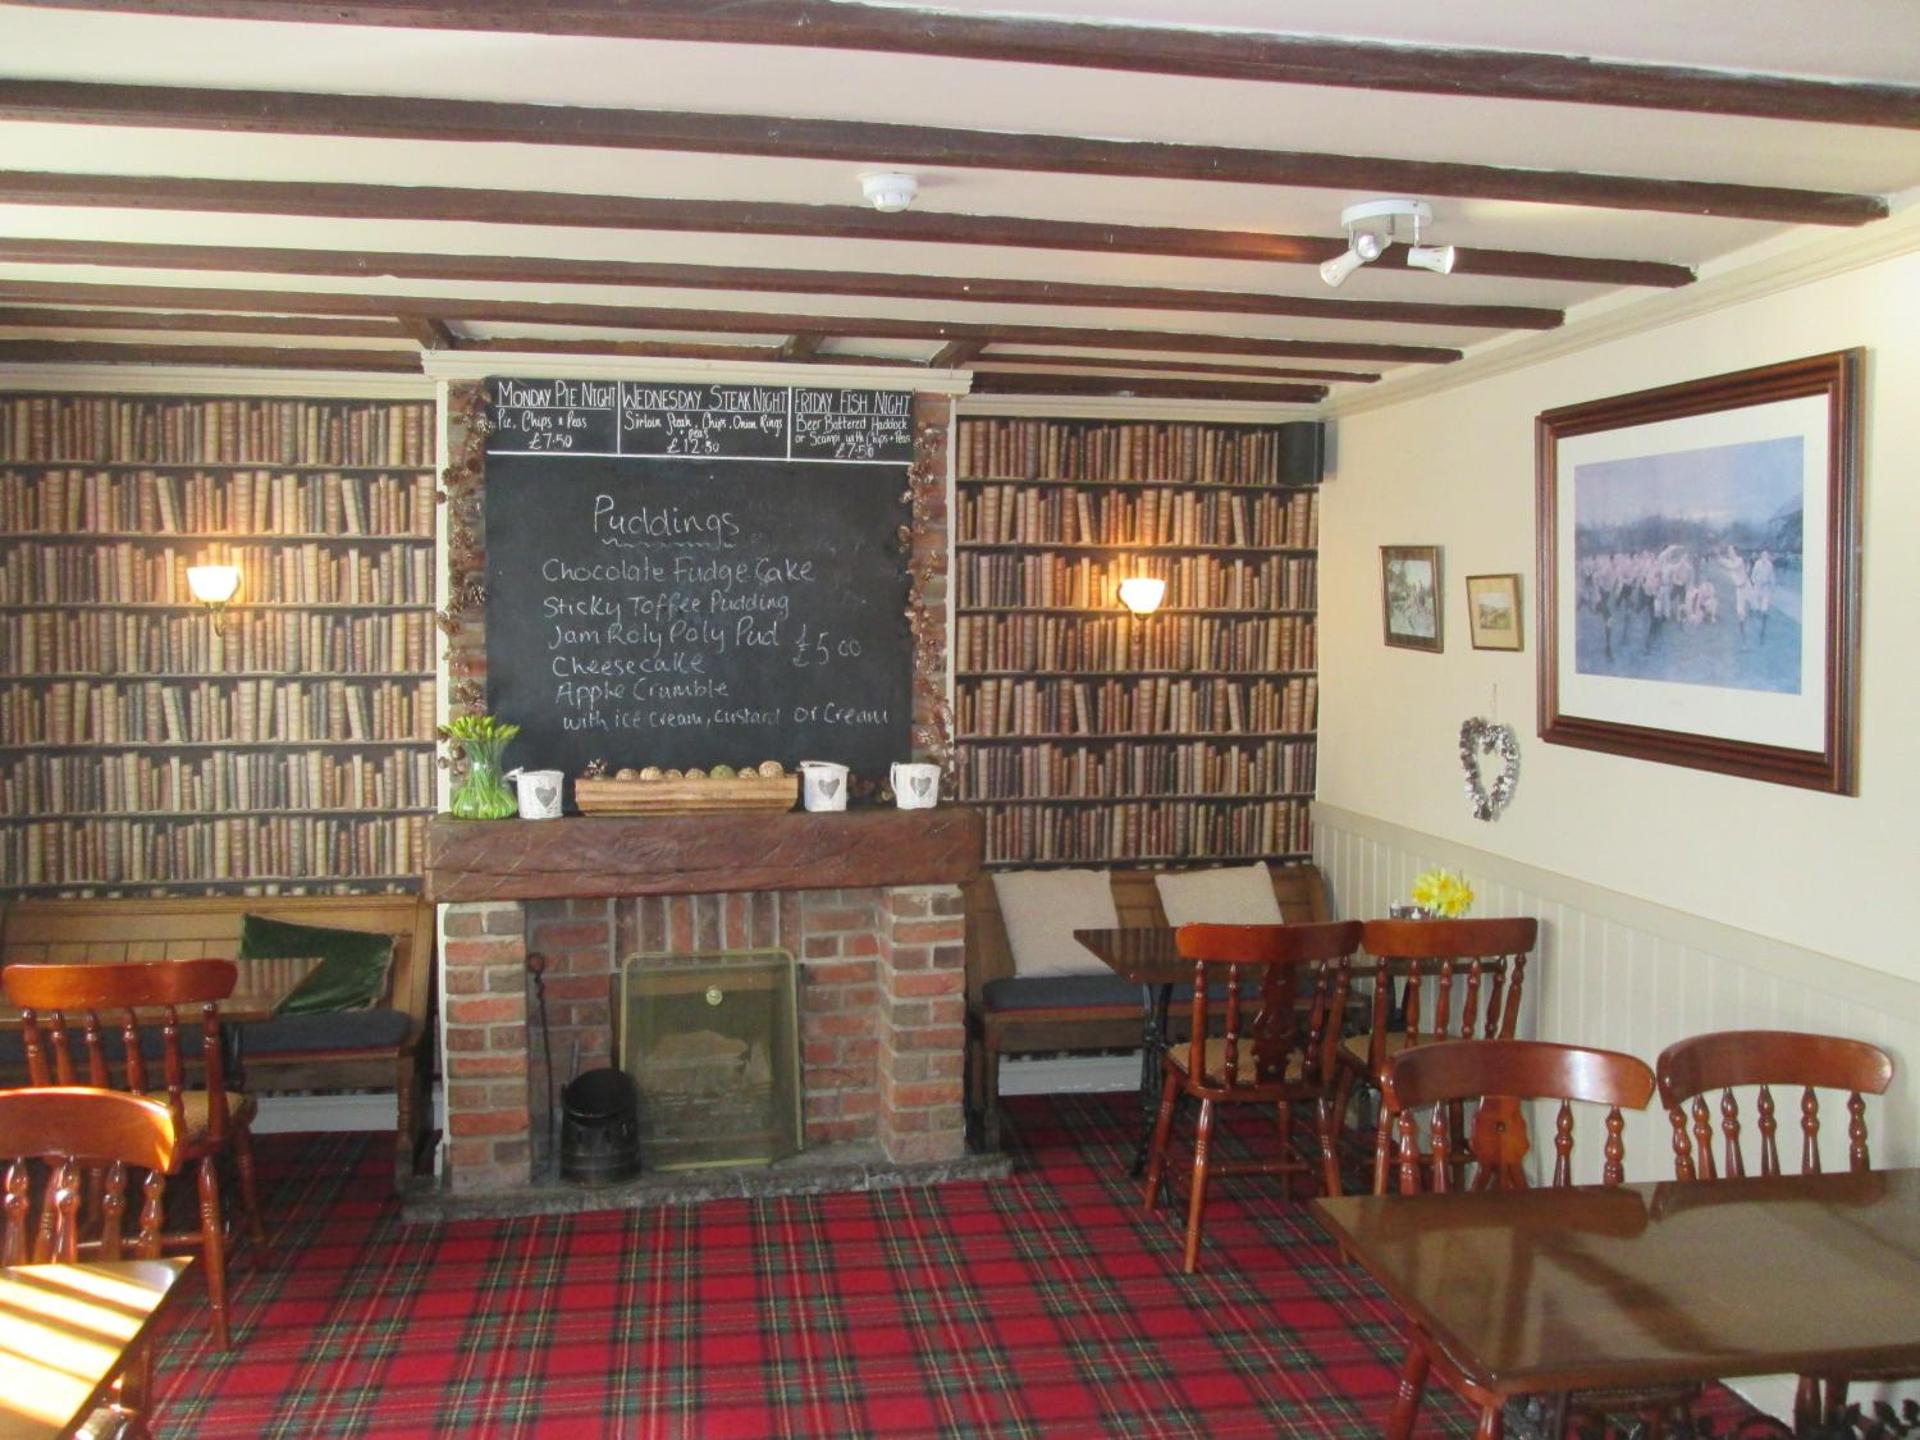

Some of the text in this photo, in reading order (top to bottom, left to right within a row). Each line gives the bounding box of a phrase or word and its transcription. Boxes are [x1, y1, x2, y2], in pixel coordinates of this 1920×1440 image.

[498, 380, 616, 408] MONDAY PIE NIGHT
[622, 383, 788, 413] WEDNESDAY STEAK NIGHT
[795, 388, 911, 415] FRIDAY FISH NIGHT
[522, 410, 552, 431] Chips
[566, 410, 587, 429] Peas
[624, 410, 662, 431] Sirloin
[733, 415, 757, 430] Onion
[760, 414, 783, 437] Rings
[796, 413, 908, 436] Beer Battered Haddock
[529, 432, 573, 449] £7.50
[795, 434, 806, 443] or
[809, 431, 840, 447] Scampi
[845, 431, 864, 442] with
[834, 442, 875, 459] £7.50
[594, 494, 740, 547] Puddings
[542, 556, 816, 592] Chocolate Fudge Cake
[543, 590, 789, 624] Sticky Toffee Pudding
[549, 615, 780, 657] Jam Roly Poly Pud
[552, 652, 706, 676] Cheesecake
[555, 677, 729, 709] Apple Crumble
[563, 711, 609, 732] with
[614, 708, 641, 728] ice
[823, 701, 889, 724] Cream
